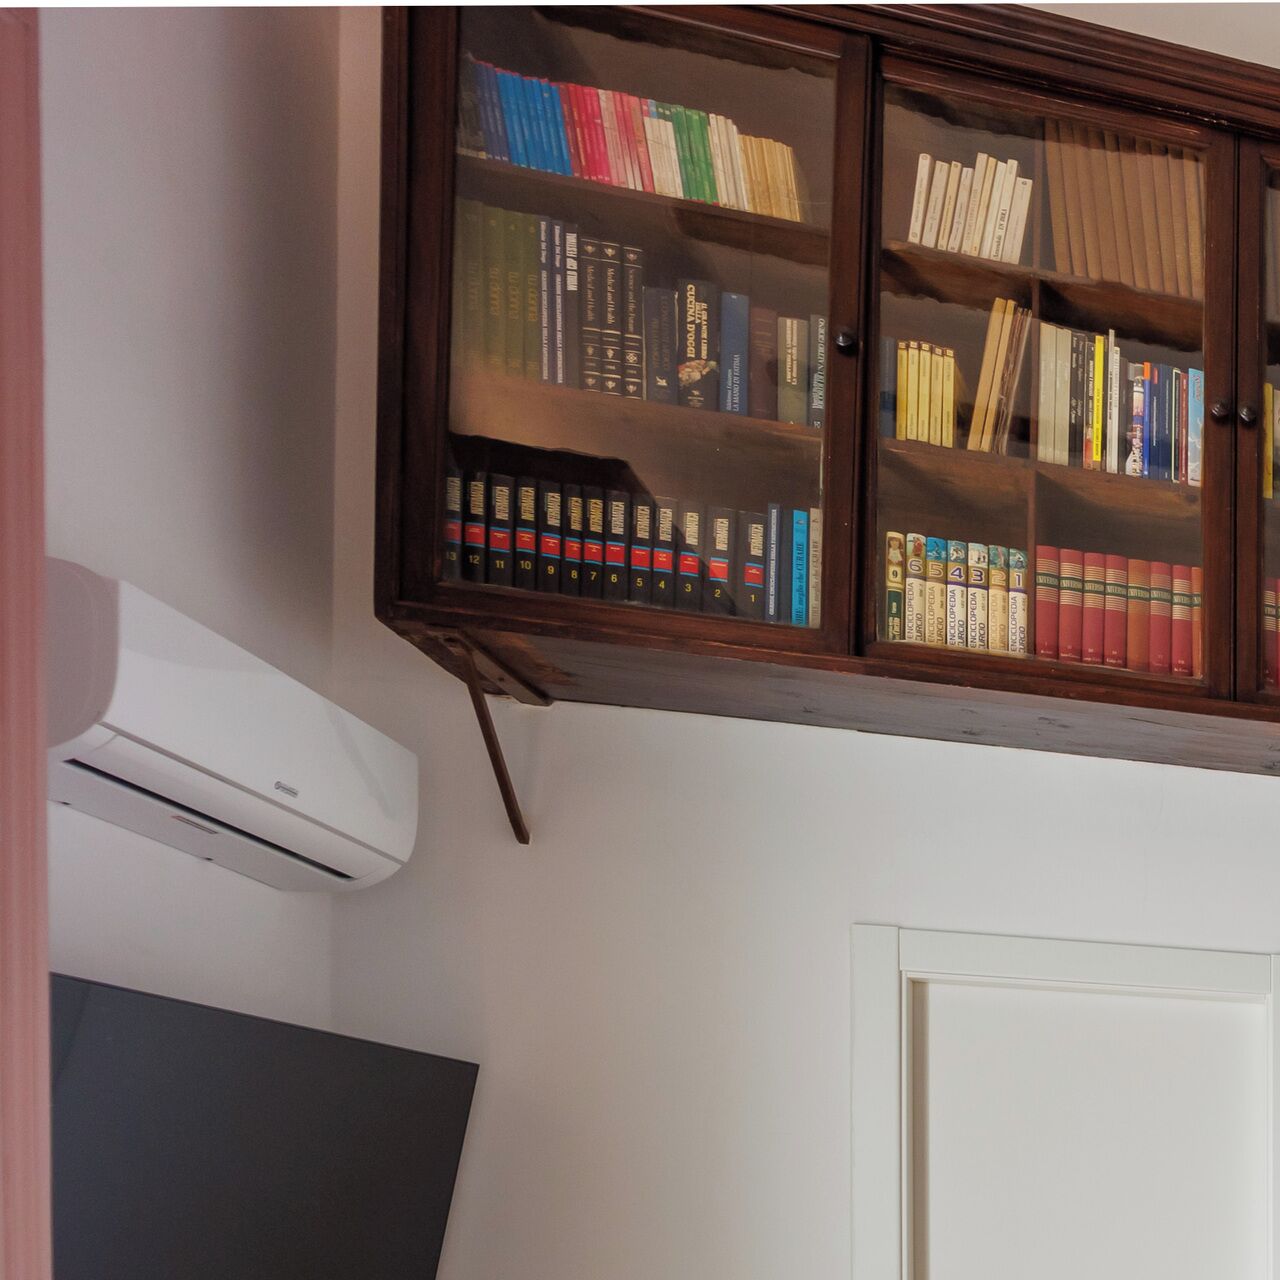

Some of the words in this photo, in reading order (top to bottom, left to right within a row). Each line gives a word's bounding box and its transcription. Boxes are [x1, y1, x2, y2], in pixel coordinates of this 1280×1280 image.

[566, 232, 578, 257] FESTIVAL
[566, 257, 578, 270] CUP
[566, 270, 578, 291] WORLD
[586, 264, 597, 288] Medical
[606, 267, 617, 290] Medical
[587, 289, 596, 299] and
[607, 291, 616, 302] and
[586, 300, 597, 321] Health
[687, 284, 696, 323] CUCINA
[606, 303, 617, 324] Health
[817, 318, 825, 343] GIORNO
[686, 324, 696, 358] D'OGGI
[700, 339, 708, 361] LIBRO
[732, 353, 741, 376] FATIMA
[732, 384, 741, 403] MANO
[732, 403, 741, 412] LA
[470, 556, 480, 565] 12
[794, 542, 805, 569] CURARE
[495, 561, 505, 570] 11
[520, 561, 531, 570] 10
[547, 566, 555, 575] 9
[908, 559, 924, 575] 6
[928, 564, 943, 577] 5
[950, 567, 963, 579] 4
[571, 571, 579, 579] 8
[591, 572, 598, 581] 7
[612, 575, 619, 584] 6
[636, 578, 643, 587] 5
[891, 570, 899, 580] 9
[971, 569, 983, 582] 3
[991, 571, 1006, 585] 2
[1015, 573, 1022, 587] 1
[659, 580, 665, 589] 4
[684, 583, 691, 593] 3
[715, 588, 722, 598] 2
[751, 594, 757, 603] 1
[907, 582, 915, 639] ENCICLOPEDIA
[948, 590, 957, 646] ENCICLOPEDIA
[915, 613, 924, 641] CURCIO
[969, 592, 977, 648] ENCICLOPEDIA
[935, 617, 945, 645] CURCIO
[957, 620, 965, 648] CURCIO
[977, 622, 986, 650] CURCIO
[1017, 626, 1026, 653] CURCIO
